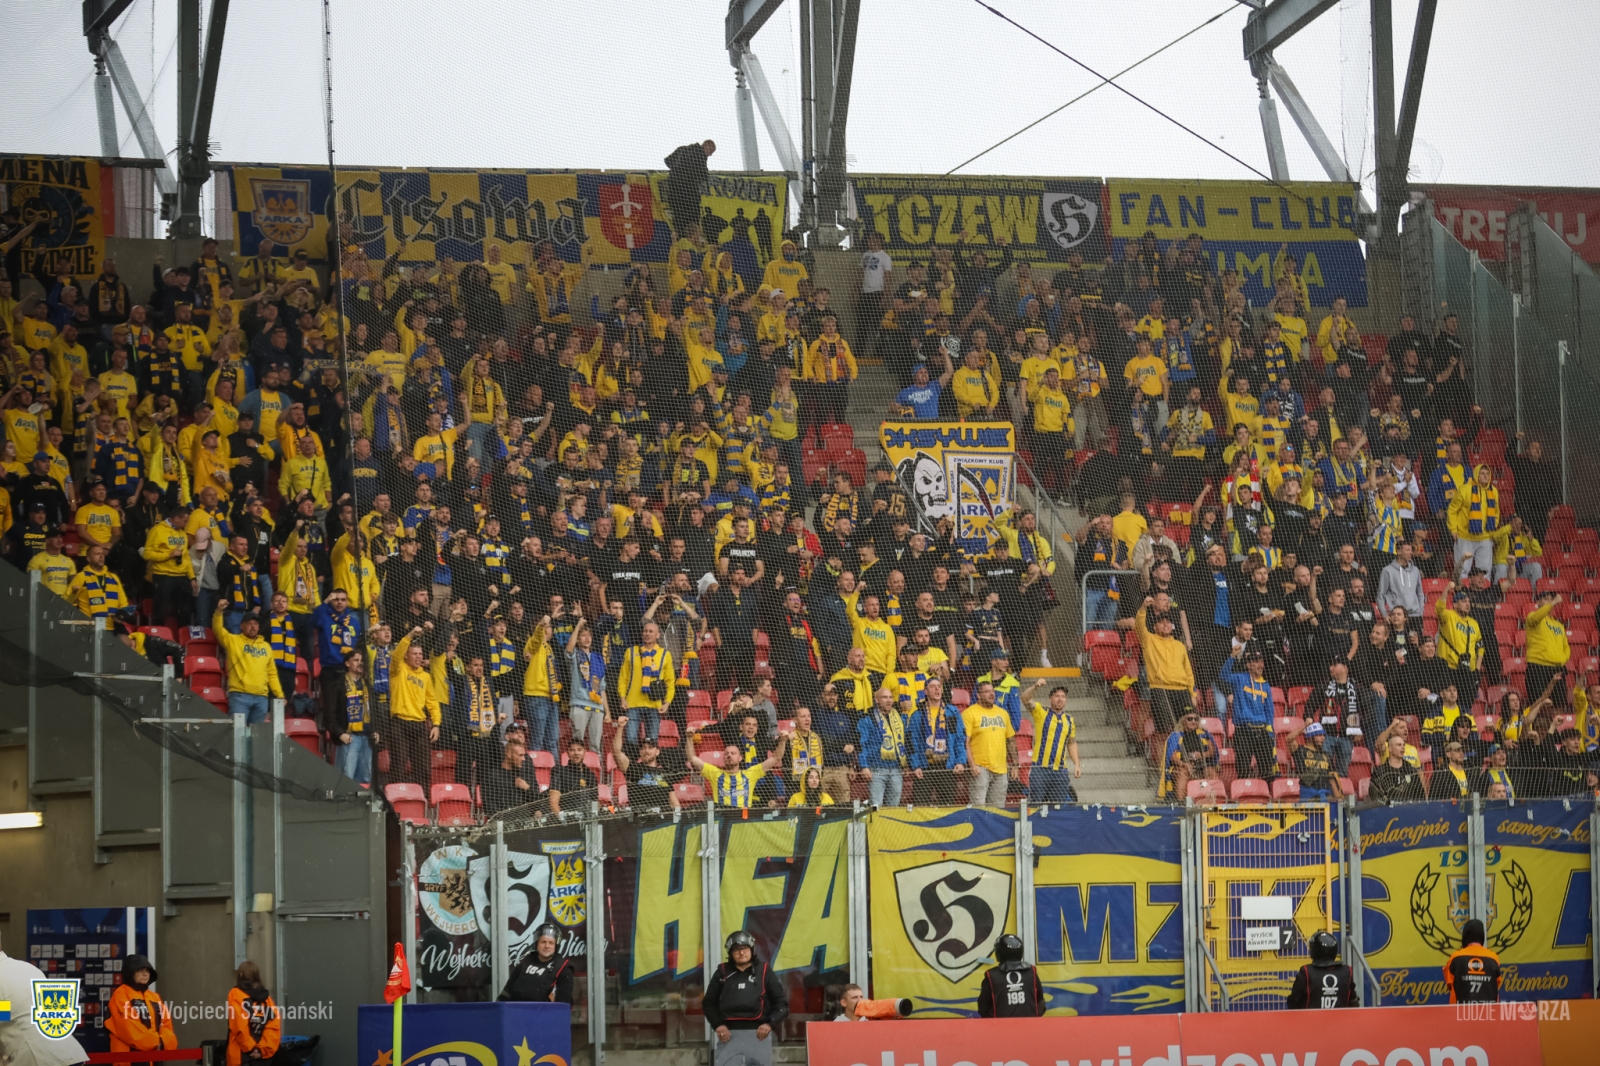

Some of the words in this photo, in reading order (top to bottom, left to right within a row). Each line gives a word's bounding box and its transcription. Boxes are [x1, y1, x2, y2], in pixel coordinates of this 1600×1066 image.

[263, 215, 305, 224] ARKA
[864, 193, 1040, 244] TCZEW
[888, 493, 906, 517] 15
[88, 513, 112, 526] ARKA
[864, 626, 887, 640] ARKA
[243, 643, 268, 657] ARKA
[980, 715, 1006, 728] ARKA
[1497, 819, 1562, 845] samego
[1439, 850, 1502, 867] 199
[550, 886, 586, 899] ARKA
[629, 819, 850, 986] HFA
[1455, 909, 1491, 917] ARA
[1282, 930, 1293, 945] 7
[1469, 982, 1483, 993] 77
[1007, 991, 1026, 1005] 198
[1320, 996, 1338, 1010] 107
